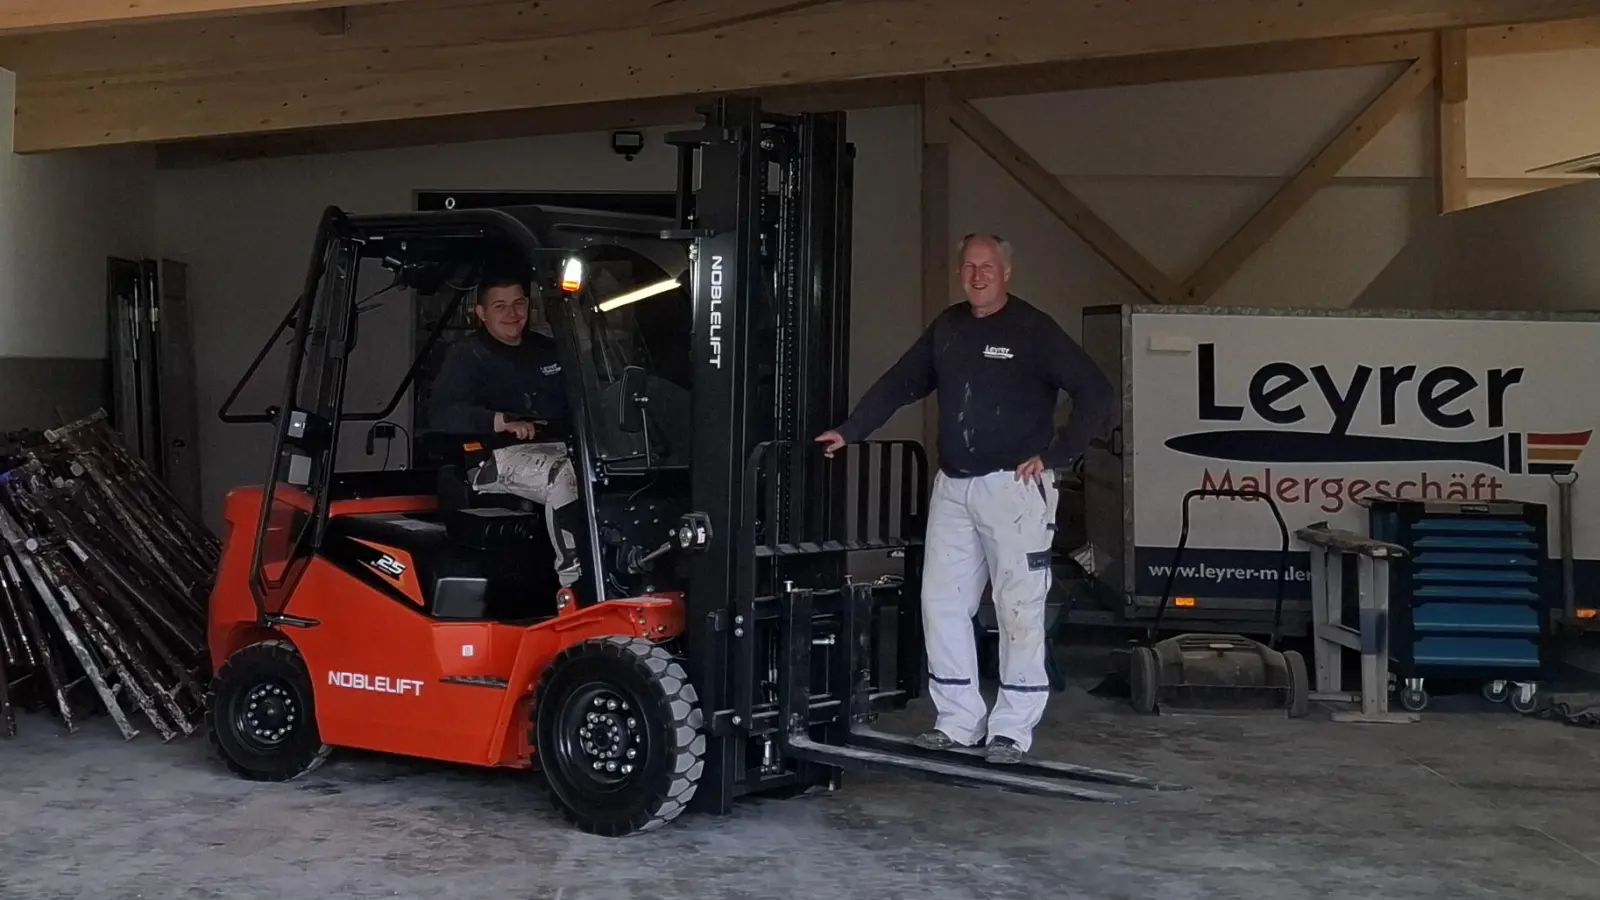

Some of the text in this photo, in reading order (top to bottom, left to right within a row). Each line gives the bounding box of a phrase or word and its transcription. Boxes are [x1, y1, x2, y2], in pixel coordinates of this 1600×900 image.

[709, 255, 723, 370] NOBLELIFT
[1198, 343, 1524, 436] Leyrer
[1199, 467, 1503, 513] Malergeschäft
[328, 670, 424, 697] NOBLELIFT
